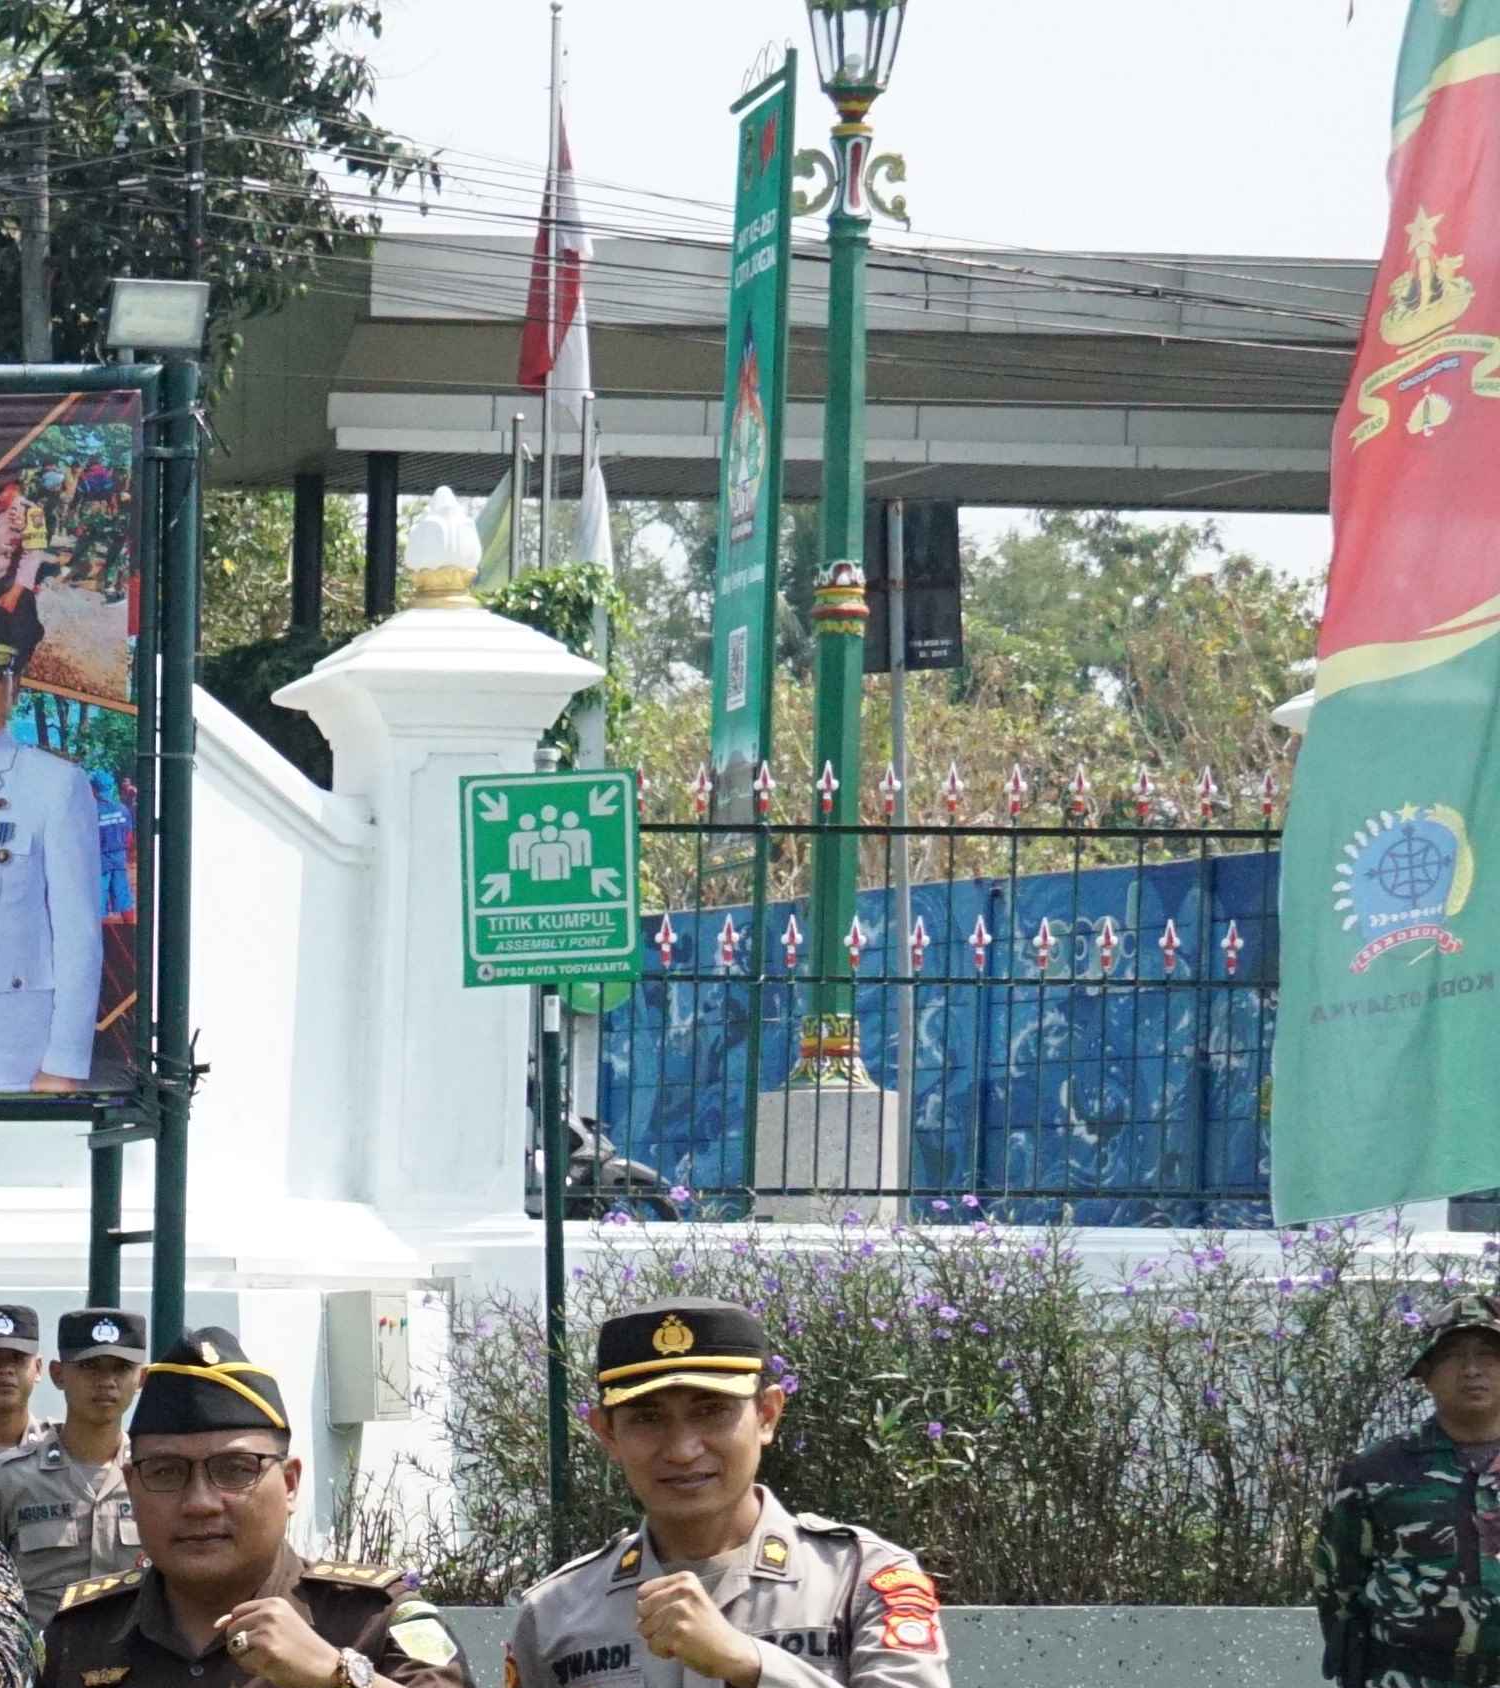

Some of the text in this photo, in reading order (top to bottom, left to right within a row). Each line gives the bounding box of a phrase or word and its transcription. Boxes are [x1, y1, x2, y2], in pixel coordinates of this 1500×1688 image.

[487, 911, 616, 932] TITIK KUMPUL
[496, 934, 611, 952] ASSEMBLY POINT
[526, 964, 558, 976] KOTA
[559, 960, 631, 975] YOGYAKARTA
